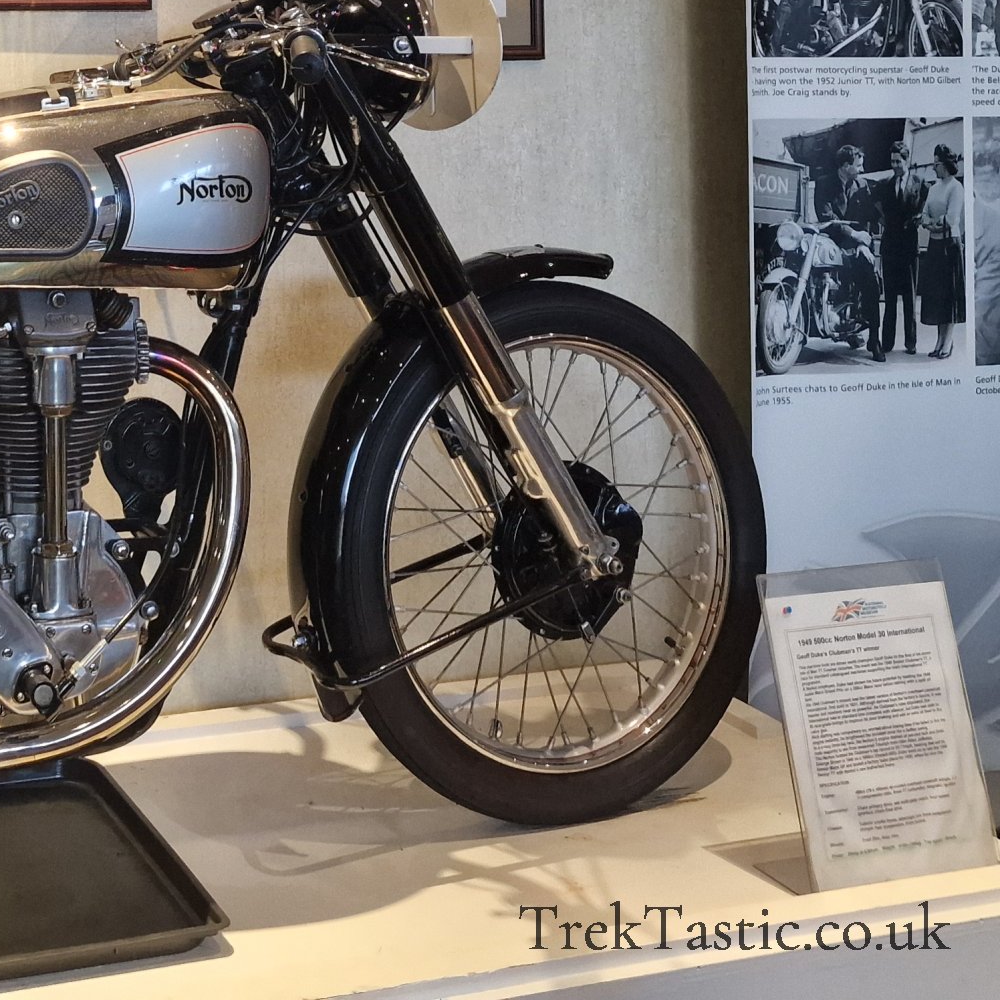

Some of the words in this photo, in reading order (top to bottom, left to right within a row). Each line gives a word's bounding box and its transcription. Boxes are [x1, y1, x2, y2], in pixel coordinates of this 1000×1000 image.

[763, 66, 777, 74] first
[780, 67, 813, 75] postwar
[816, 66, 868, 75] motorcycling
[870, 67, 903, 75] superstar
[909, 66, 928, 74] Geoff
[755, 77, 776, 86] having
[799, 77, 813, 85] the
[817, 77, 835, 85] 1952
[838, 77, 862, 85] Junior
[878, 76, 895, 84] with
[937, 76, 961, 84] Gilbert
[788, 89, 809, 97] Craig
[972, 98, 995, 107] speed
[176, 174, 253, 205] Norton
[975, 374, 996, 384] Geoff
[772, 385, 802, 394] Surtees
[805, 384, 827, 393] chats
[840, 383, 864, 392] Geoff
[866, 383, 886, 391] Duke
[888, 381, 895, 390] in
[897, 381, 909, 389] the
[912, 380, 923, 388] Isle
[925, 379, 934, 387] of
[954, 377, 961, 385] in
[856, 631, 876, 640] Model
[887, 626, 925, 637] International
